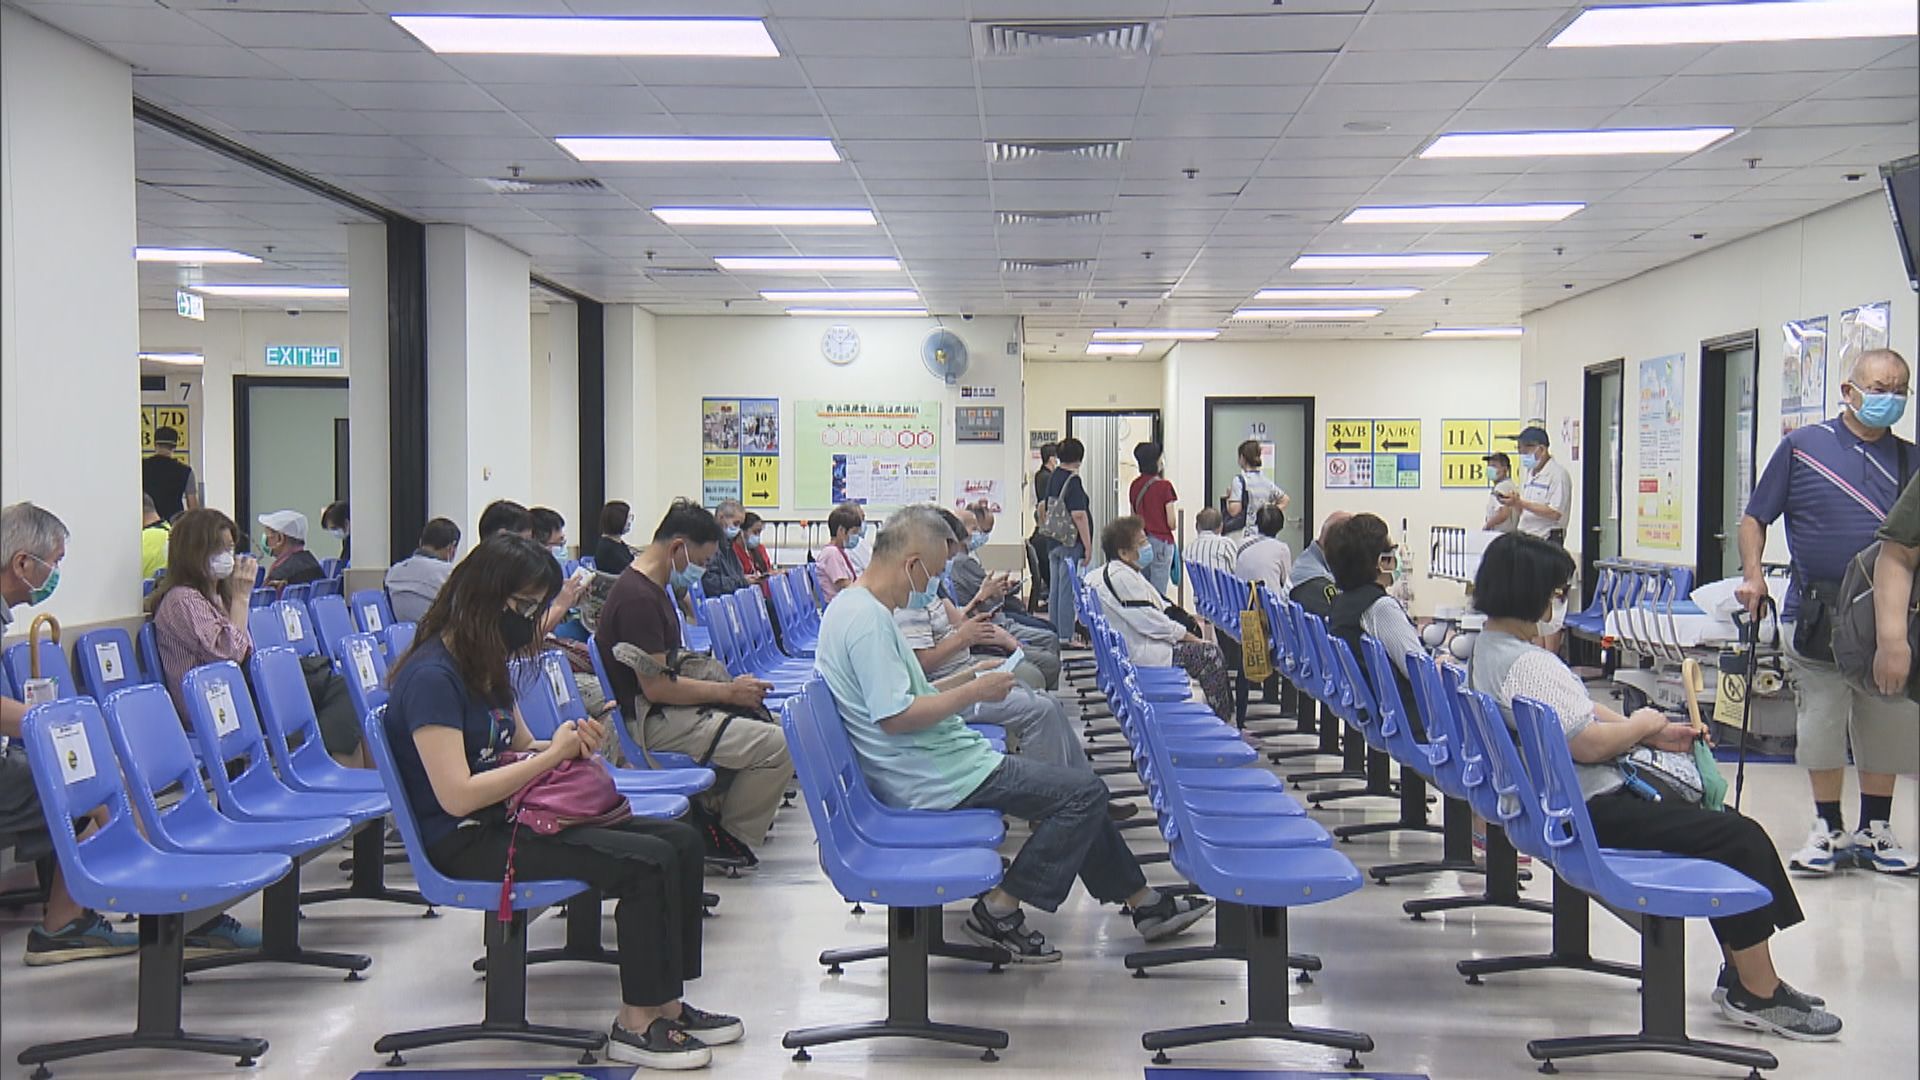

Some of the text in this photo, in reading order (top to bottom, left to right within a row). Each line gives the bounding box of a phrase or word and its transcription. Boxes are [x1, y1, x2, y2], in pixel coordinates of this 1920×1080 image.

[266, 347, 310, 365] EXIT
[311, 347, 341, 365] 出口
[180, 383, 191, 401] 7
[160, 412, 185, 427] 7D
[1250, 422, 1266, 434] 10
[1332, 424, 1366, 438] 8A/B
[1449, 429, 1484, 446] 11A
[756, 472, 768, 482] 10
[1448, 463, 1484, 480] 11B
